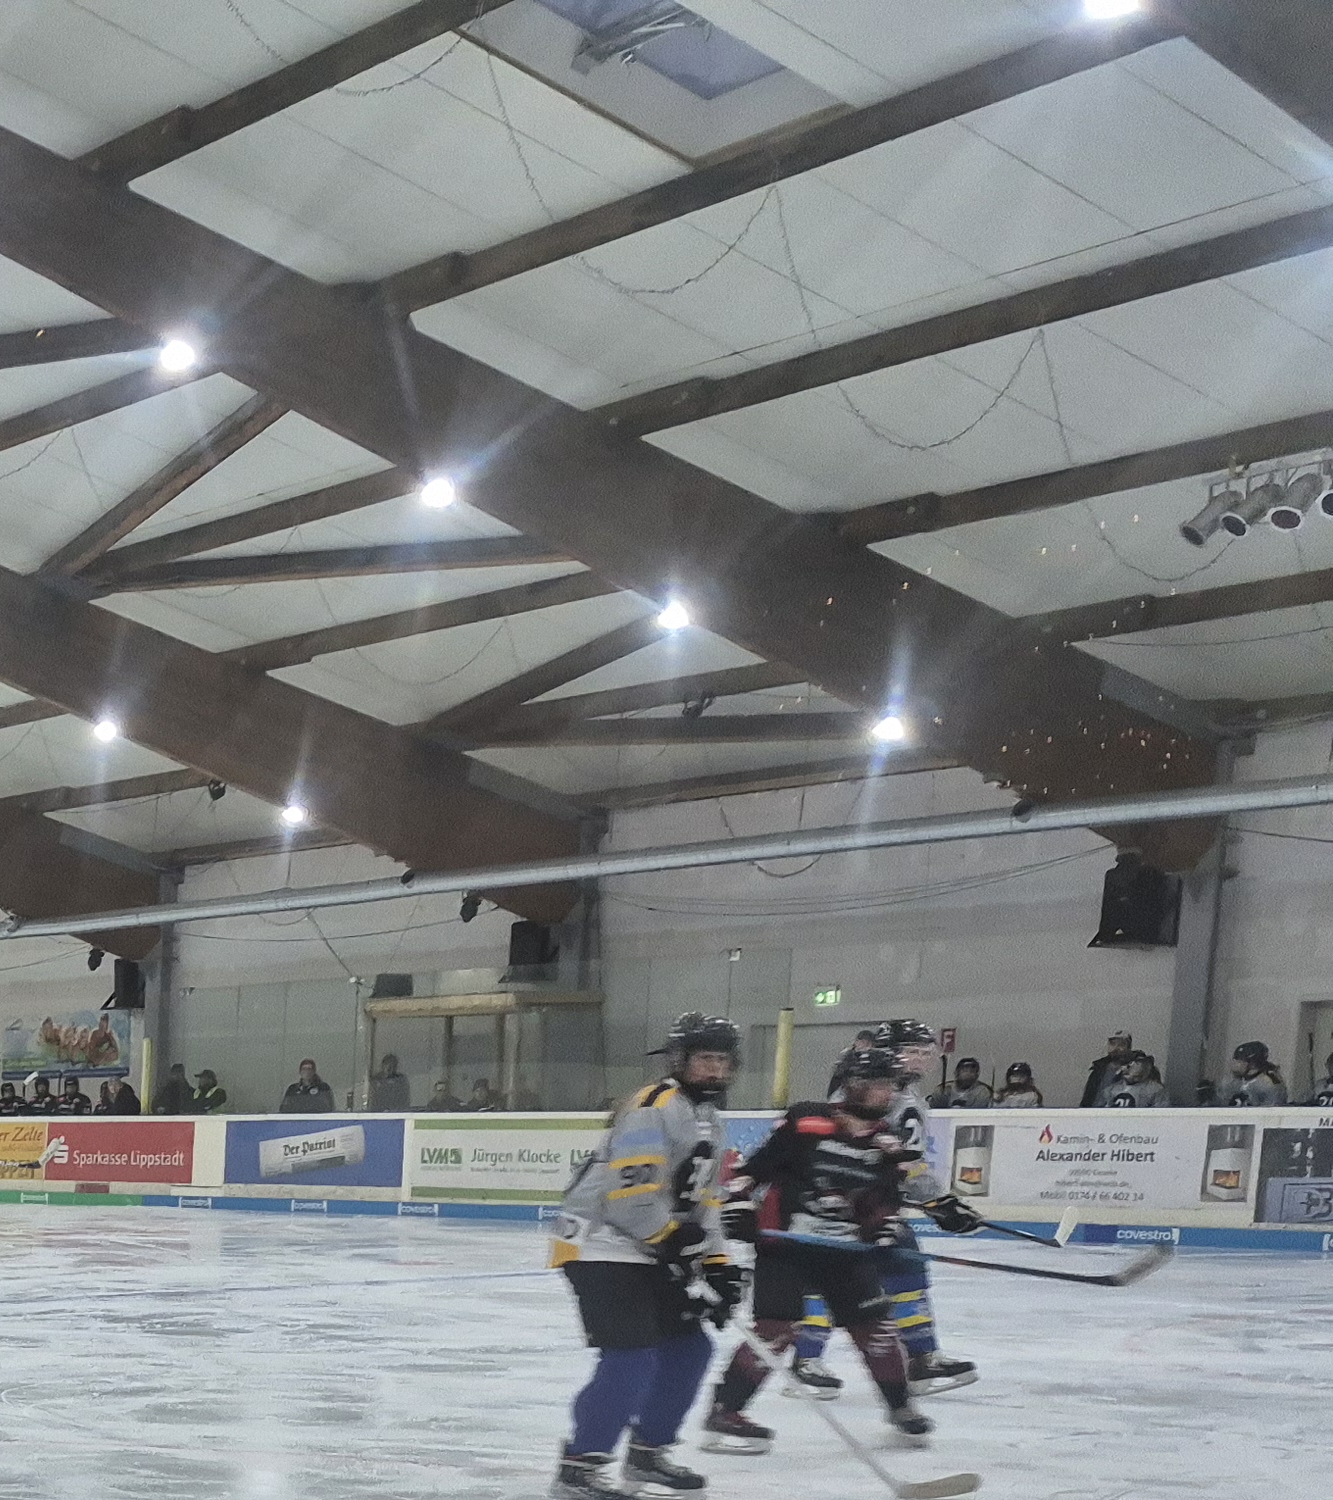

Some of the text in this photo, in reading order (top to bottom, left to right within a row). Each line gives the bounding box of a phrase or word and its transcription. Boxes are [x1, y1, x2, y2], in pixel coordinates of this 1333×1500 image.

[12, 1126, 44, 1142] Zelte
[1056, 1133, 1159, 1144] Kamin- & Ofenbau
[283, 1143, 300, 1156] Der
[1035, 1149, 1156, 1163] Alexander Hibert
[72, 1149, 185, 1169] Sparkasse Lippstadt
[471, 1148, 561, 1166] Jürgen Klocke
[1117, 1228, 1171, 1241] covestro
